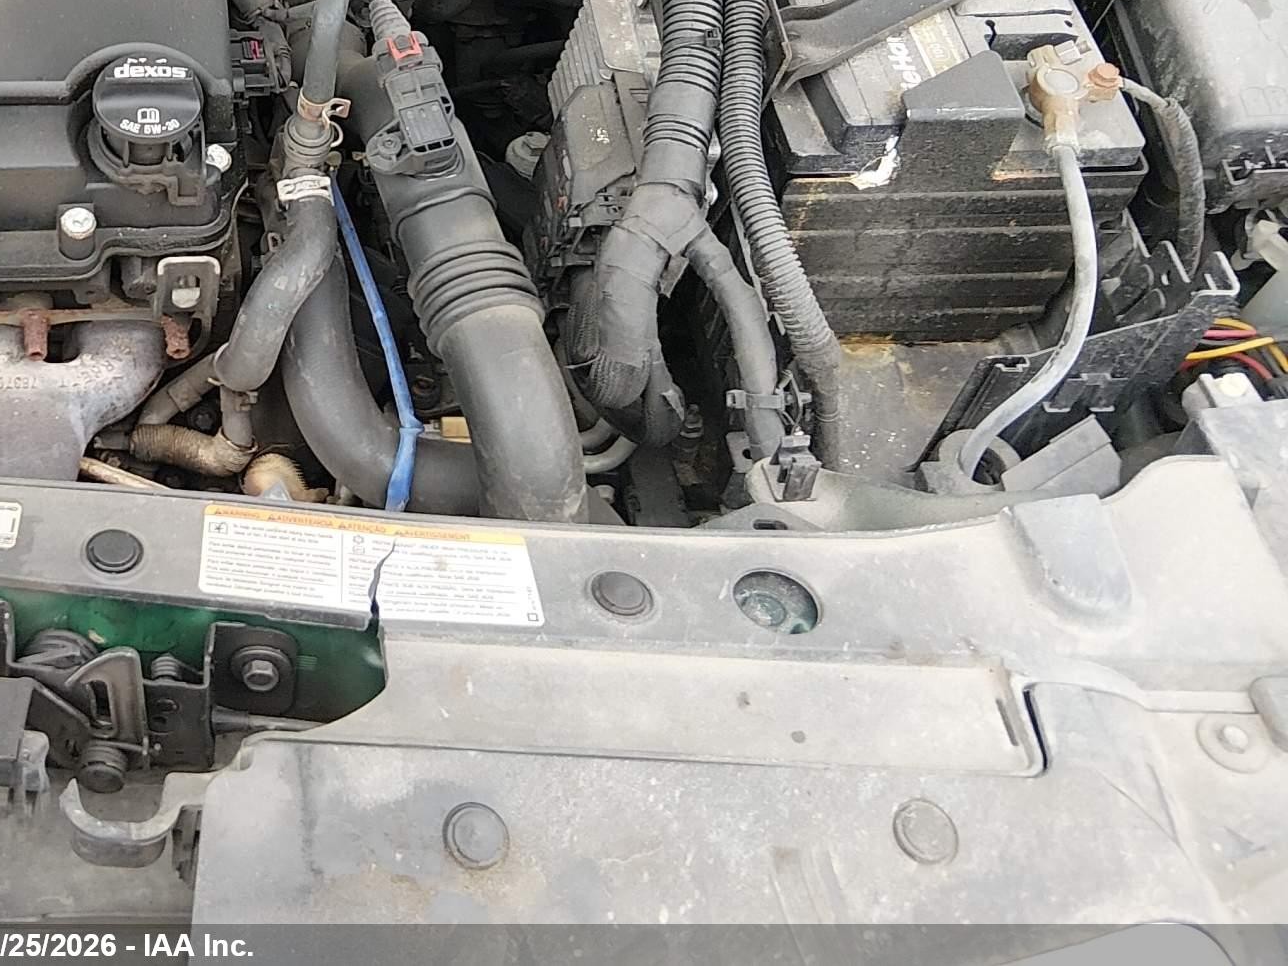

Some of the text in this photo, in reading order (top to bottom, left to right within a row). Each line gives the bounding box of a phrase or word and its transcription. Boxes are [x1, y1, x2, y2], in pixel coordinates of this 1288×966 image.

[113, 63, 189, 78] dexos
[119, 118, 180, 135] SAE 5W-30
